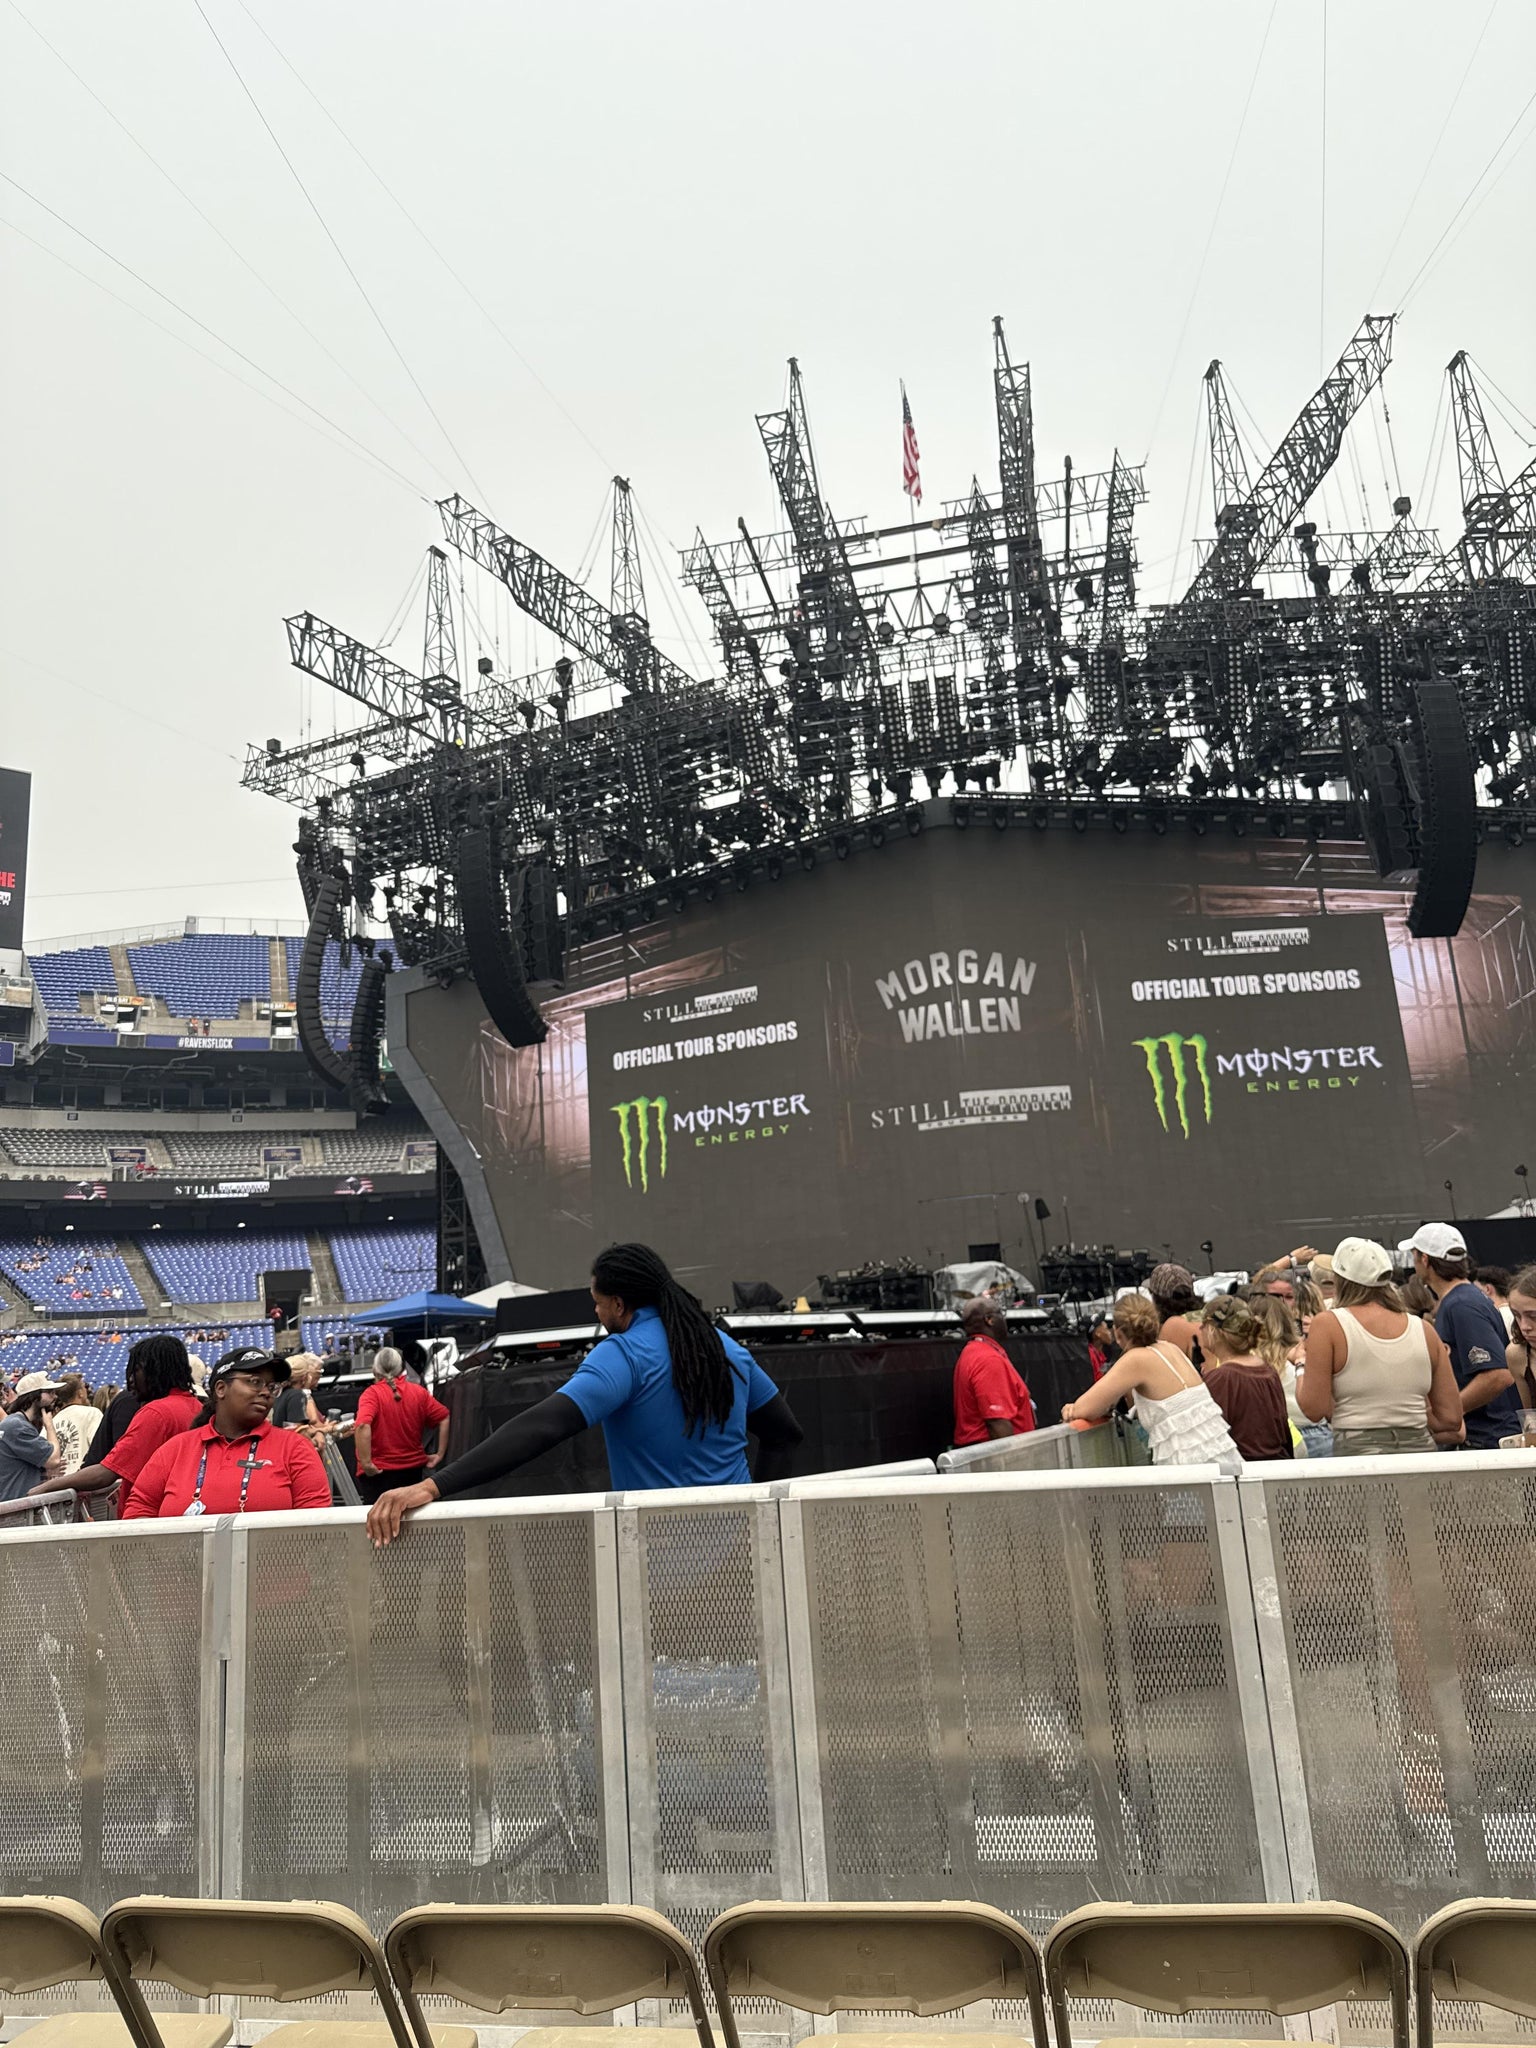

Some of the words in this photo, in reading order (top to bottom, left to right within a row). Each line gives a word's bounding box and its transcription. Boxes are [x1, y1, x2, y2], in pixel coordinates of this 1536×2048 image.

[0, 871, 16, 888] HE
[1167, 936, 1231, 953] STILL
[875, 949, 1037, 1010] MORGAN
[1131, 978, 1210, 1001] OFFICIAL
[1211, 975, 1261, 997] TOUR
[1263, 969, 1361, 994] SPONSORS
[643, 1003, 694, 1022] STILL
[898, 997, 1021, 1043] WALLEN
[178, 1037, 233, 1049] #RAVENSFLOCK
[613, 1044, 673, 1071] OFFICIAL
[675, 1036, 714, 1059] TOUR
[716, 1021, 798, 1052] SPONSORS
[1216, 1046, 1383, 1078] MONSTER
[1246, 1076, 1359, 1094] ENERGY
[673, 1093, 811, 1133] MONSTER
[871, 1100, 957, 1129] STILL
[999, 1092, 1071, 1113] PROBLEM
[696, 1124, 790, 1146] ENERGY
[174, 1185, 218, 1195] STILL
